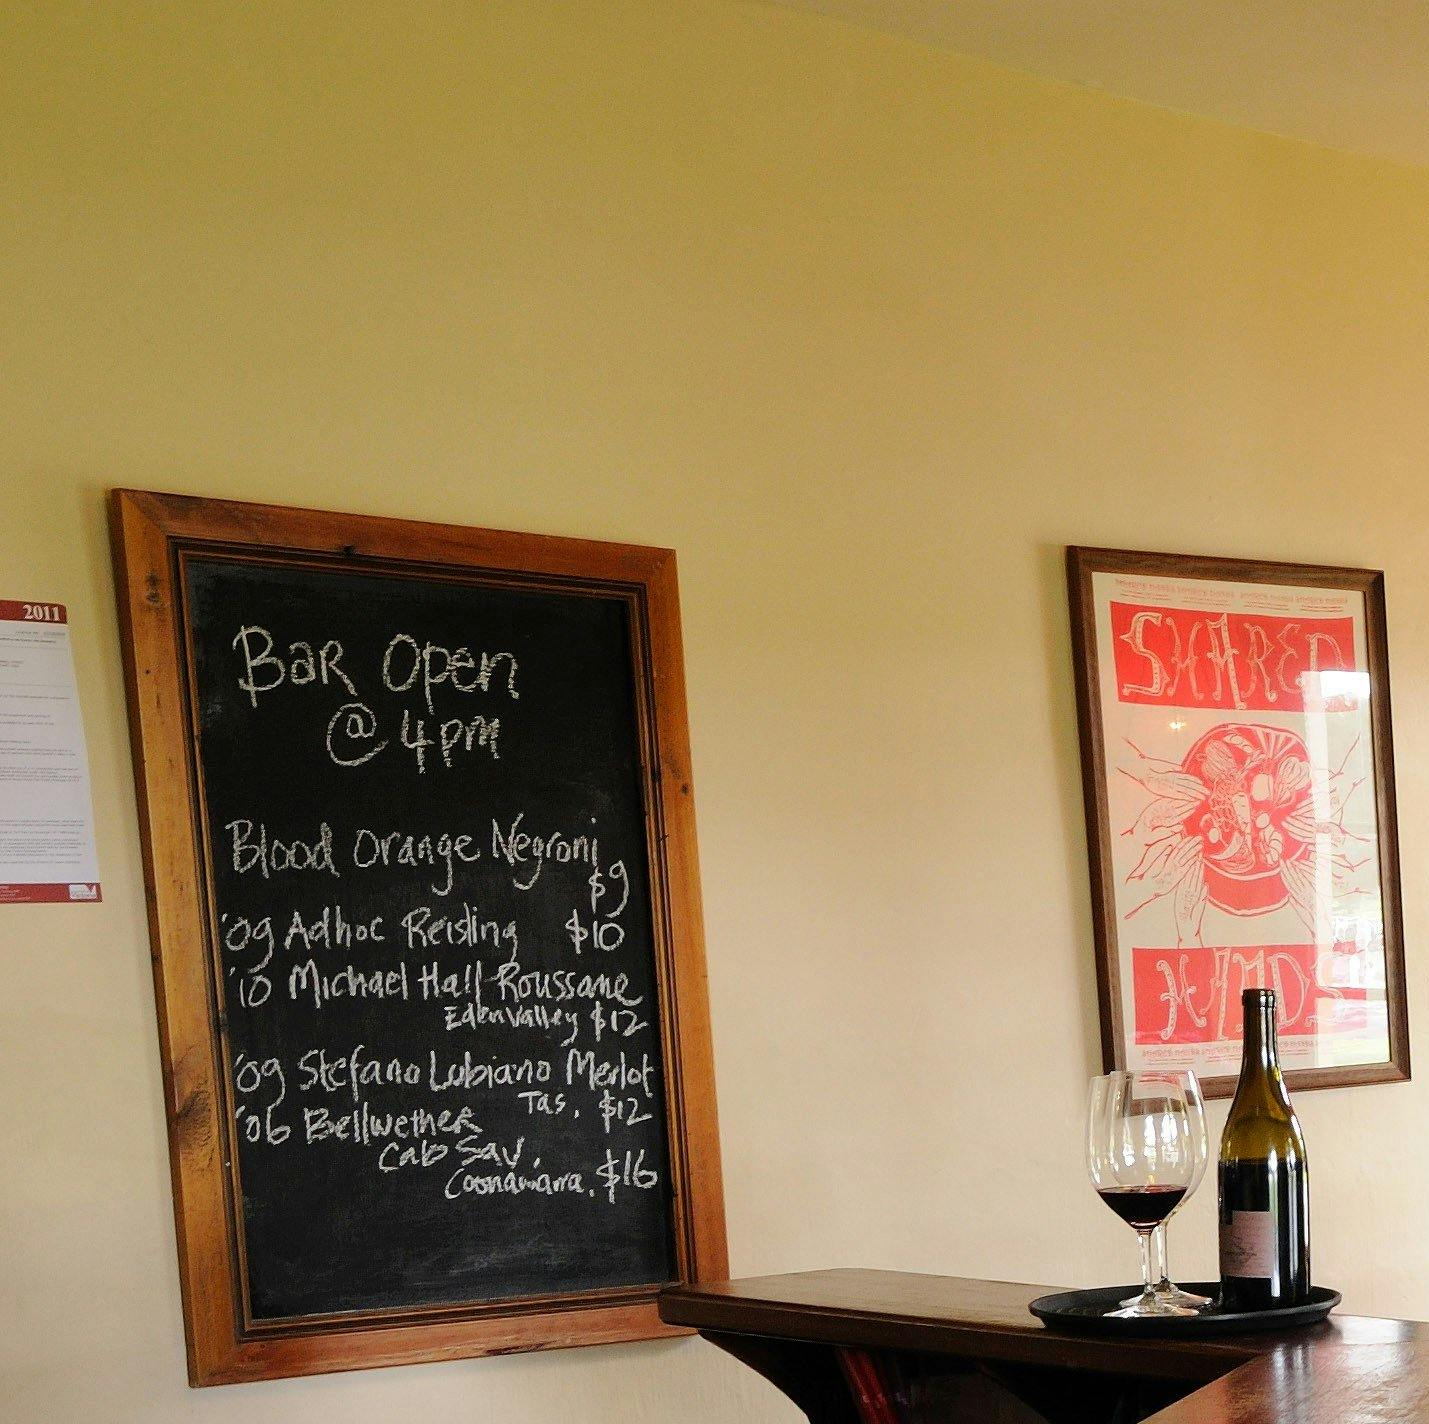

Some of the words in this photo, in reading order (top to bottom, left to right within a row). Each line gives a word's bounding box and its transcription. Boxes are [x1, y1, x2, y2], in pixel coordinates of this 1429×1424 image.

[22, 604, 61, 621] 2011
[382, 633, 520, 714] Open
[326, 703, 390, 766] @
[225, 819, 340, 878] Blood
[353, 829, 481, 896] Orange
[492, 813, 600, 890] Negroni
[589, 860, 630, 918] $9
[284, 905, 386, 950] Adhoc
[565, 908, 626, 954] $10
[288, 958, 409, 1009] Michael
[417, 960, 483, 1008] Hall
[589, 1000, 649, 1043] $12
[298, 1044, 421, 1101] Stefano
[566, 1048, 654, 1099] Merlot
[599, 1089, 653, 1134] $12
[378, 1139, 449, 1174] Cab
[595, 1148, 659, 1205] $16
